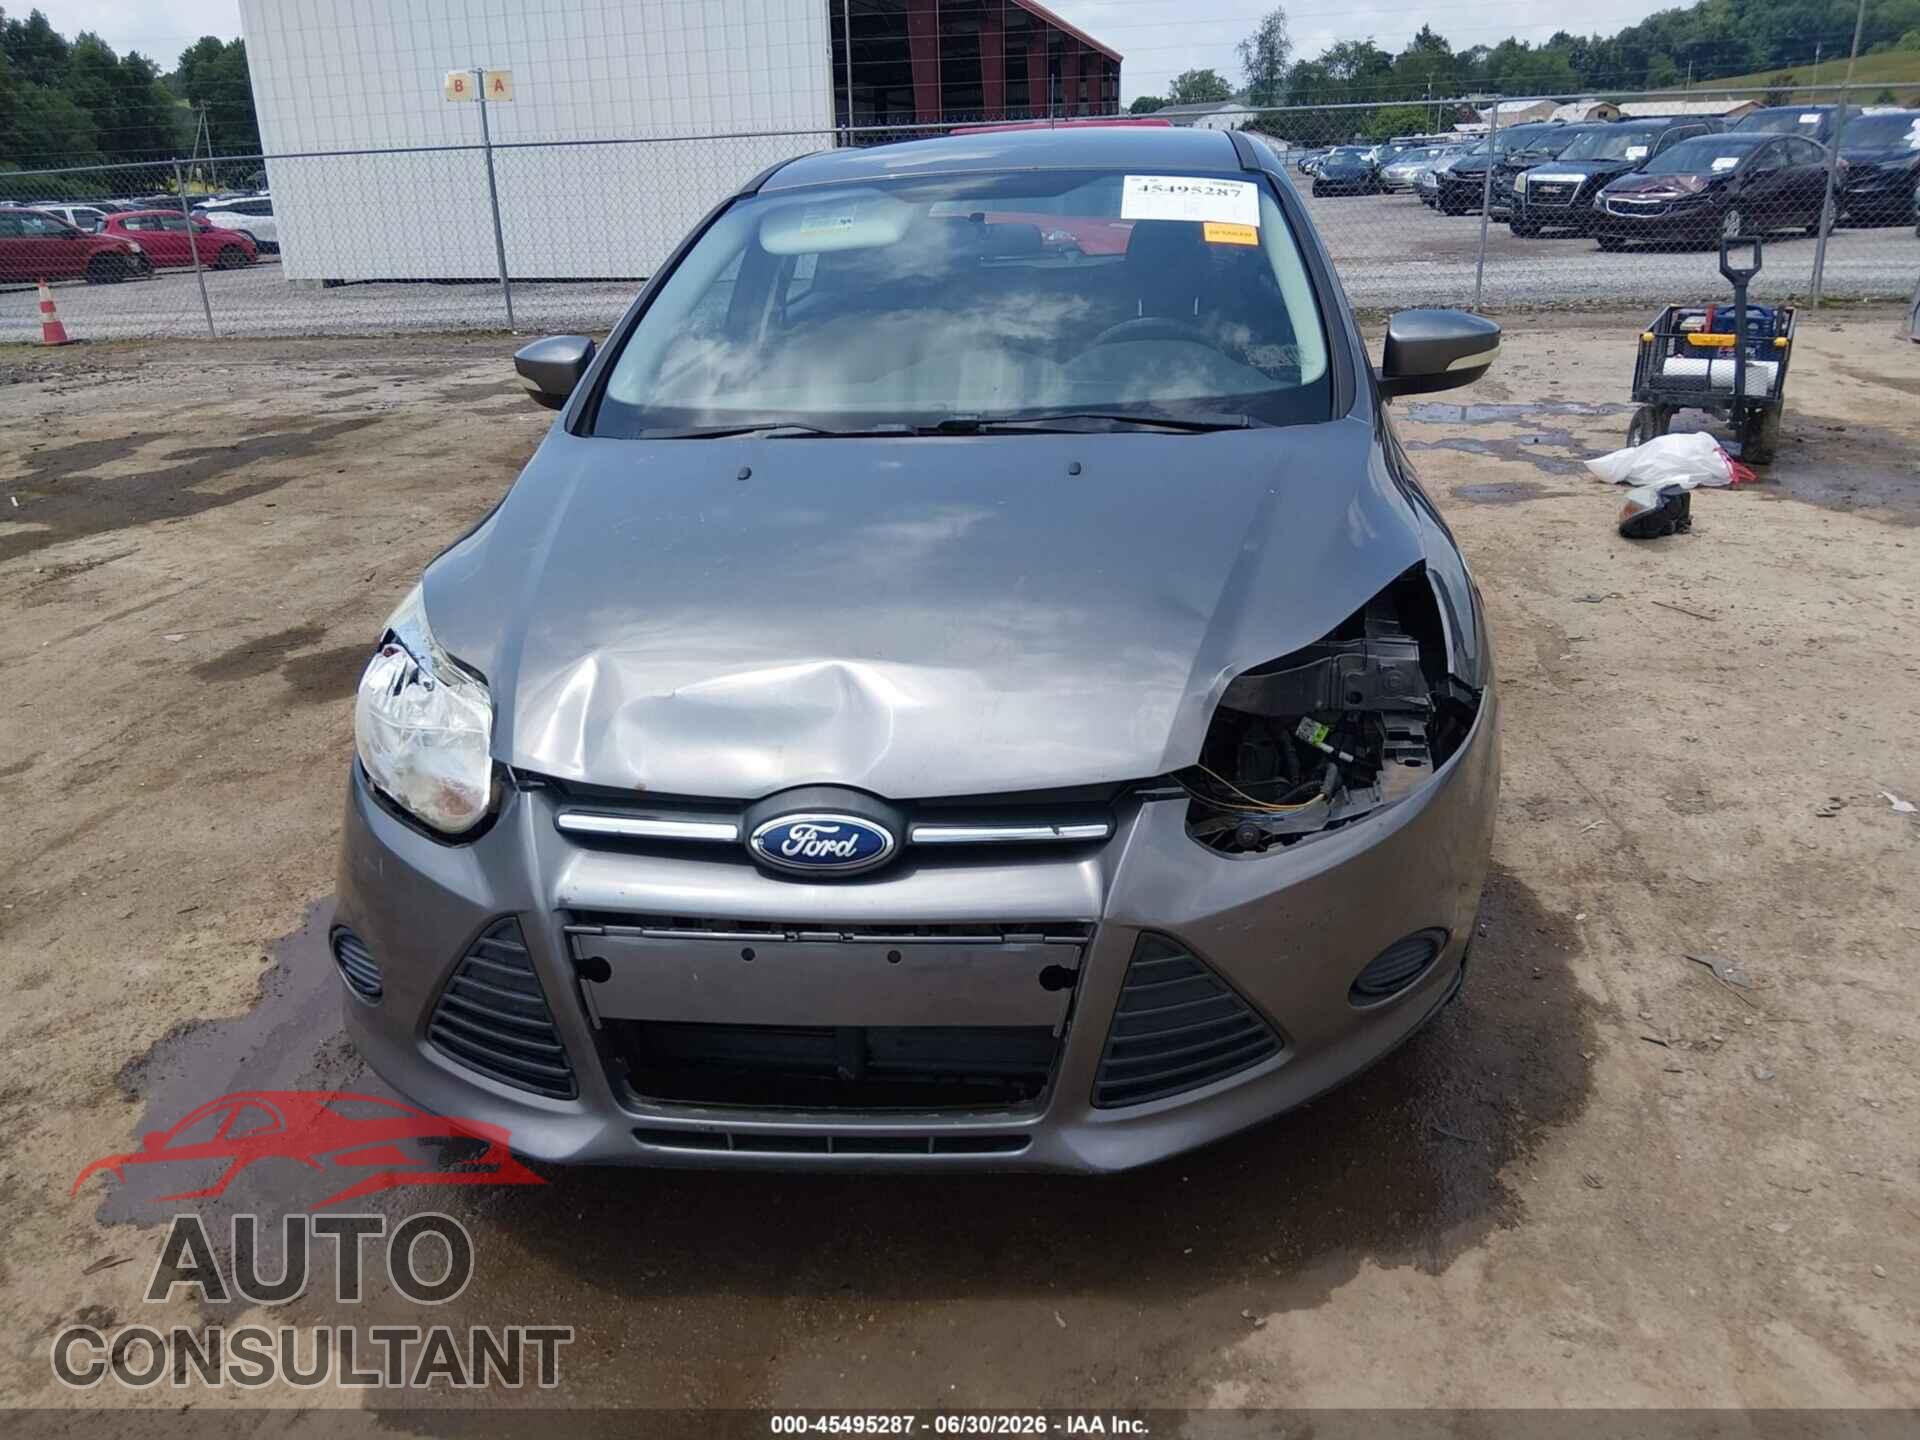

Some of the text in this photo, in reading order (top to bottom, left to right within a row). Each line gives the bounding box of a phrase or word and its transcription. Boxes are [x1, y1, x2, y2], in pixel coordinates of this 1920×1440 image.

[454, 79, 464, 92] B
[494, 79, 505, 92] A
[1138, 184, 1241, 198] 45495287
[781, 823, 860, 857] Ford
